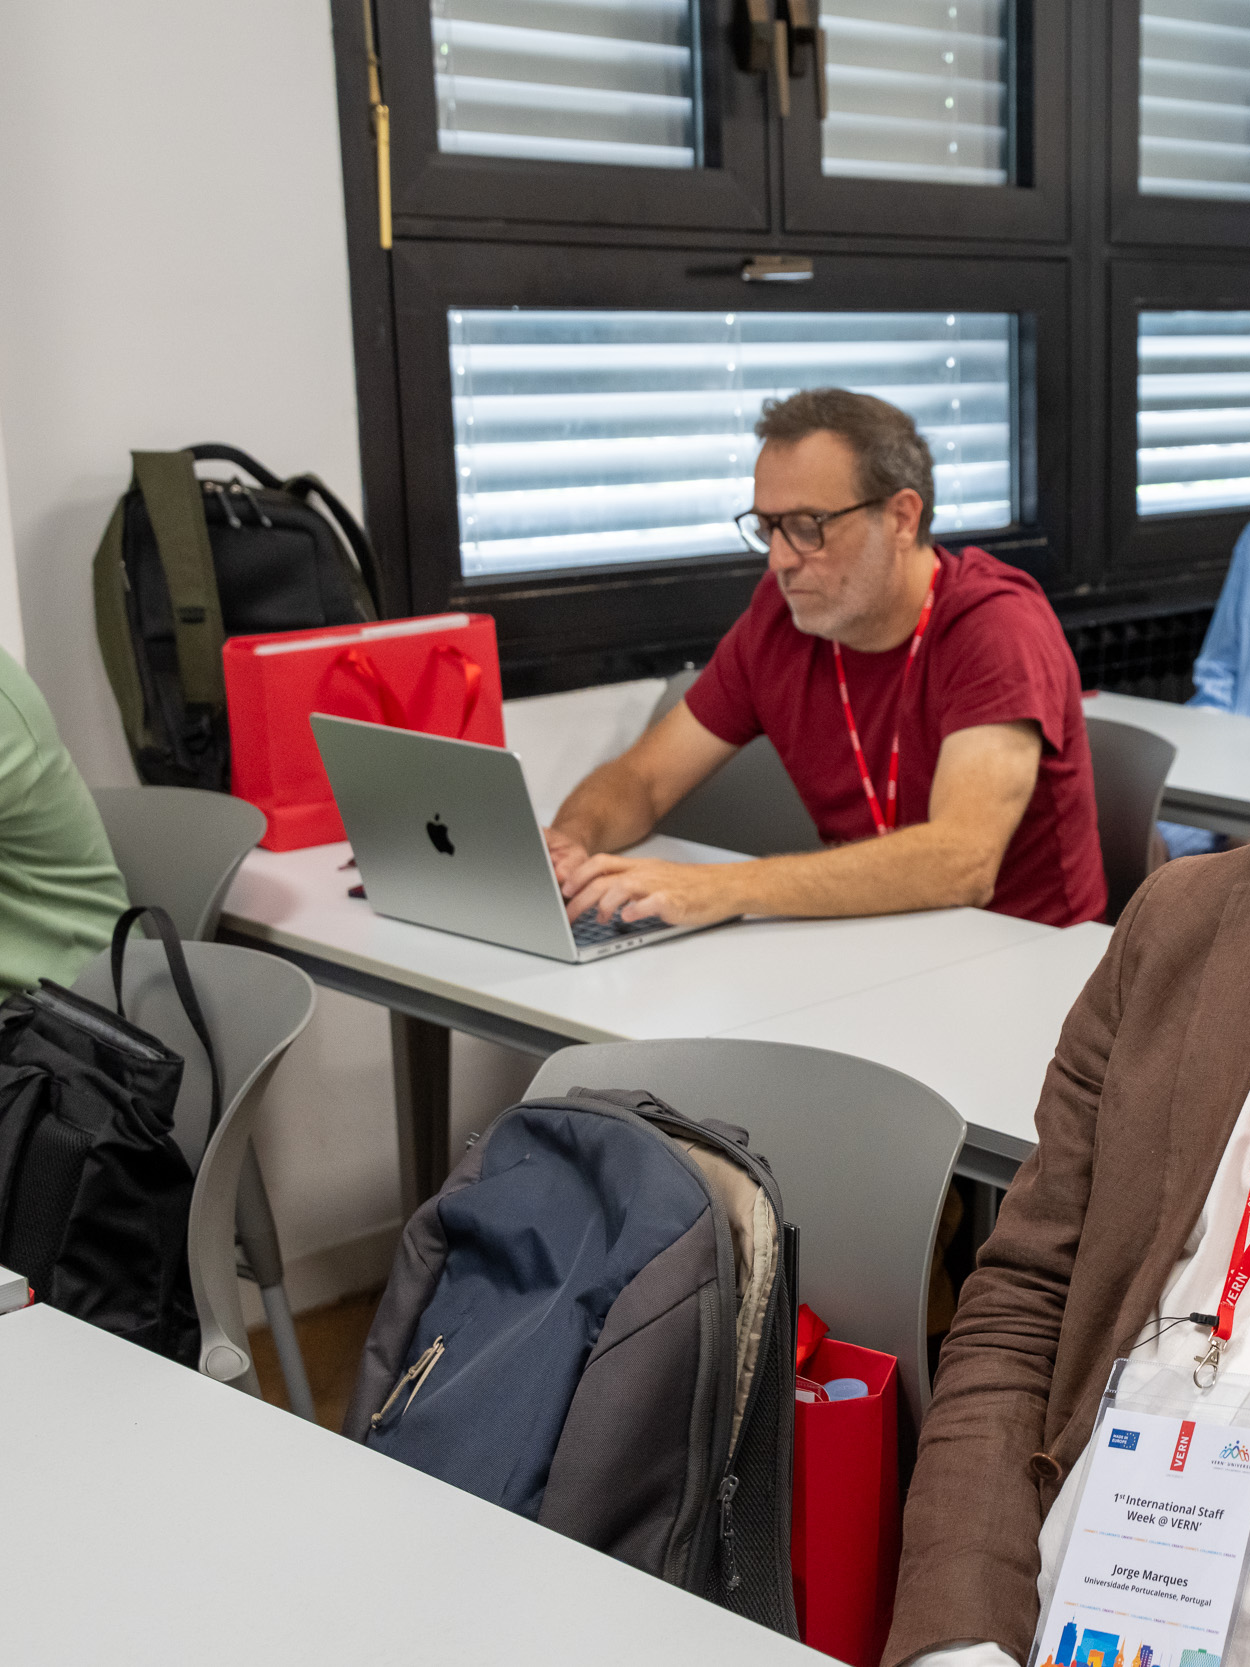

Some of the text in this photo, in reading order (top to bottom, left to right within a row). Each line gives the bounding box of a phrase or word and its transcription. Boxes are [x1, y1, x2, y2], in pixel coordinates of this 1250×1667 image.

[1126, 1495, 1196, 1516] International
[1198, 1507, 1225, 1520] Staff
[1127, 1510, 1156, 1524] Week
[1158, 1516, 1168, 1527] @
[1111, 1564, 1189, 1587] Jorge Marques
[1084, 1576, 1212, 1607] Universidade Portucalense, Portugal
